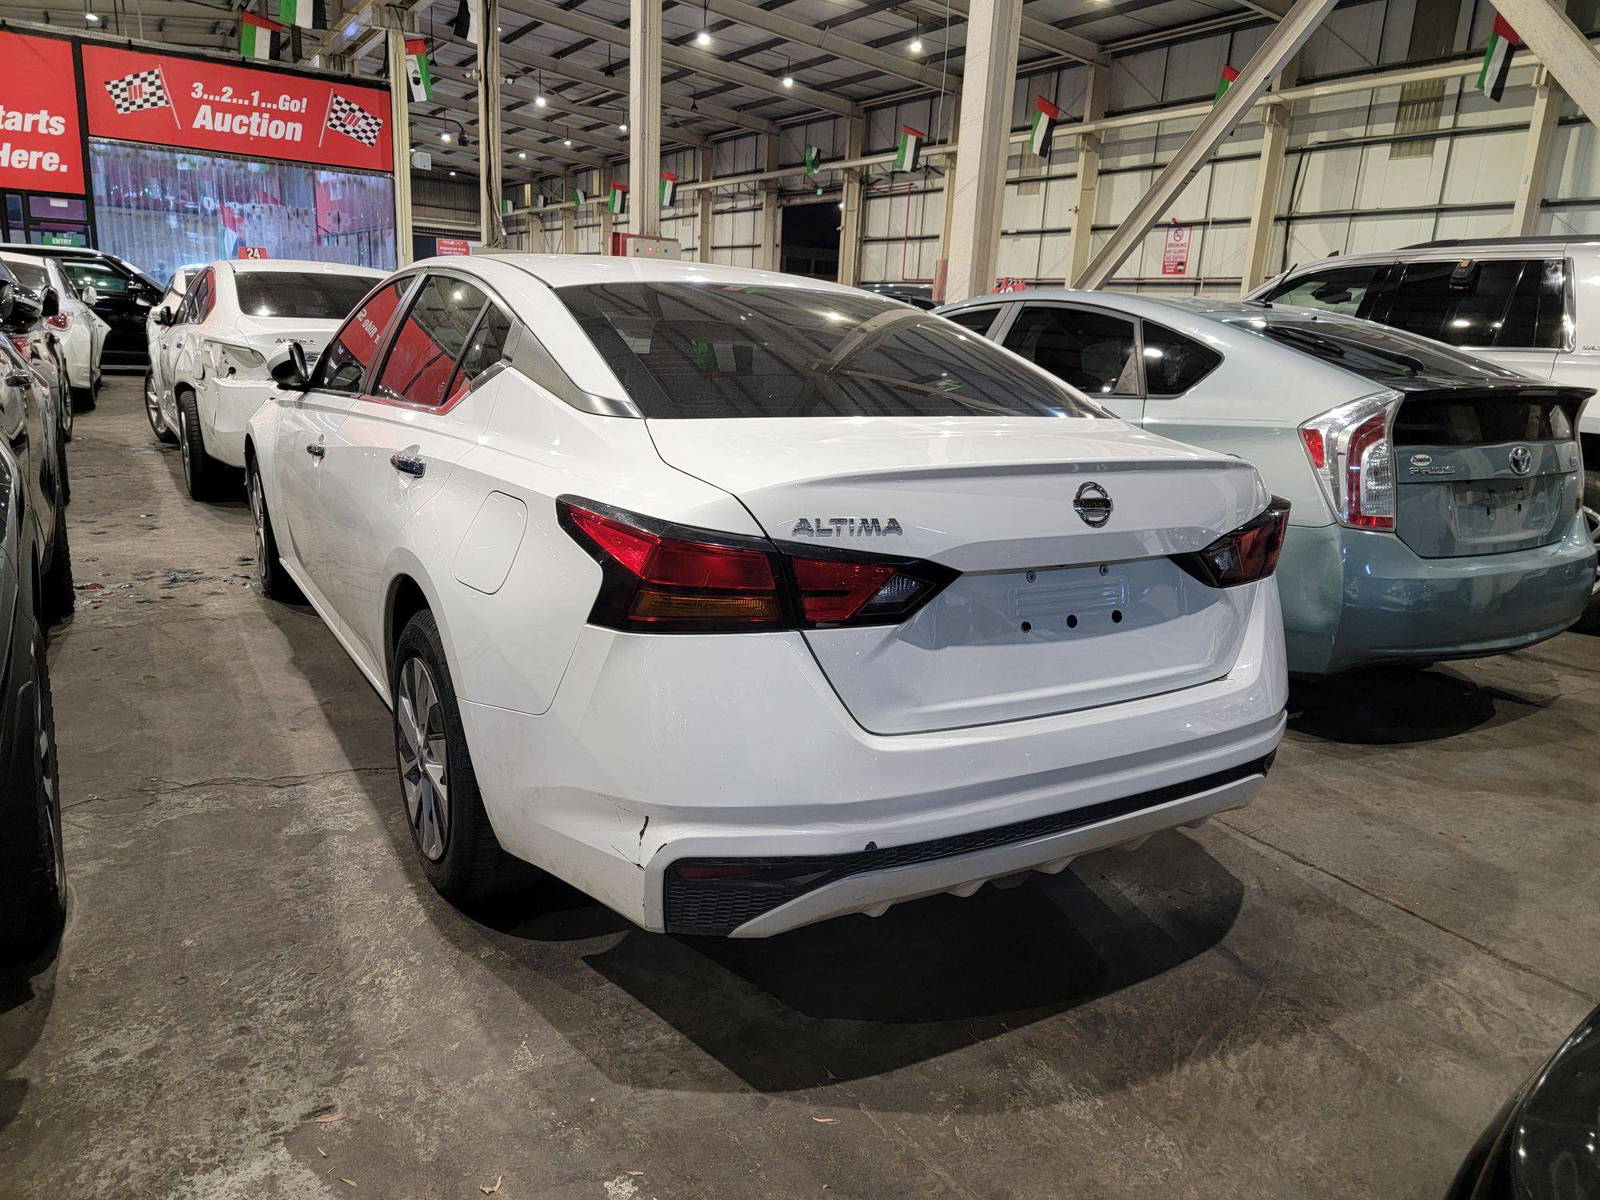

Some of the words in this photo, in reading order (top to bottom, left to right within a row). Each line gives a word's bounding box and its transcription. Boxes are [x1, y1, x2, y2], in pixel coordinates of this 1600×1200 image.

[192, 104, 303, 142] Auction
[52, 237, 72, 245] ENTRY
[791, 517, 903, 538] ALTIMA
